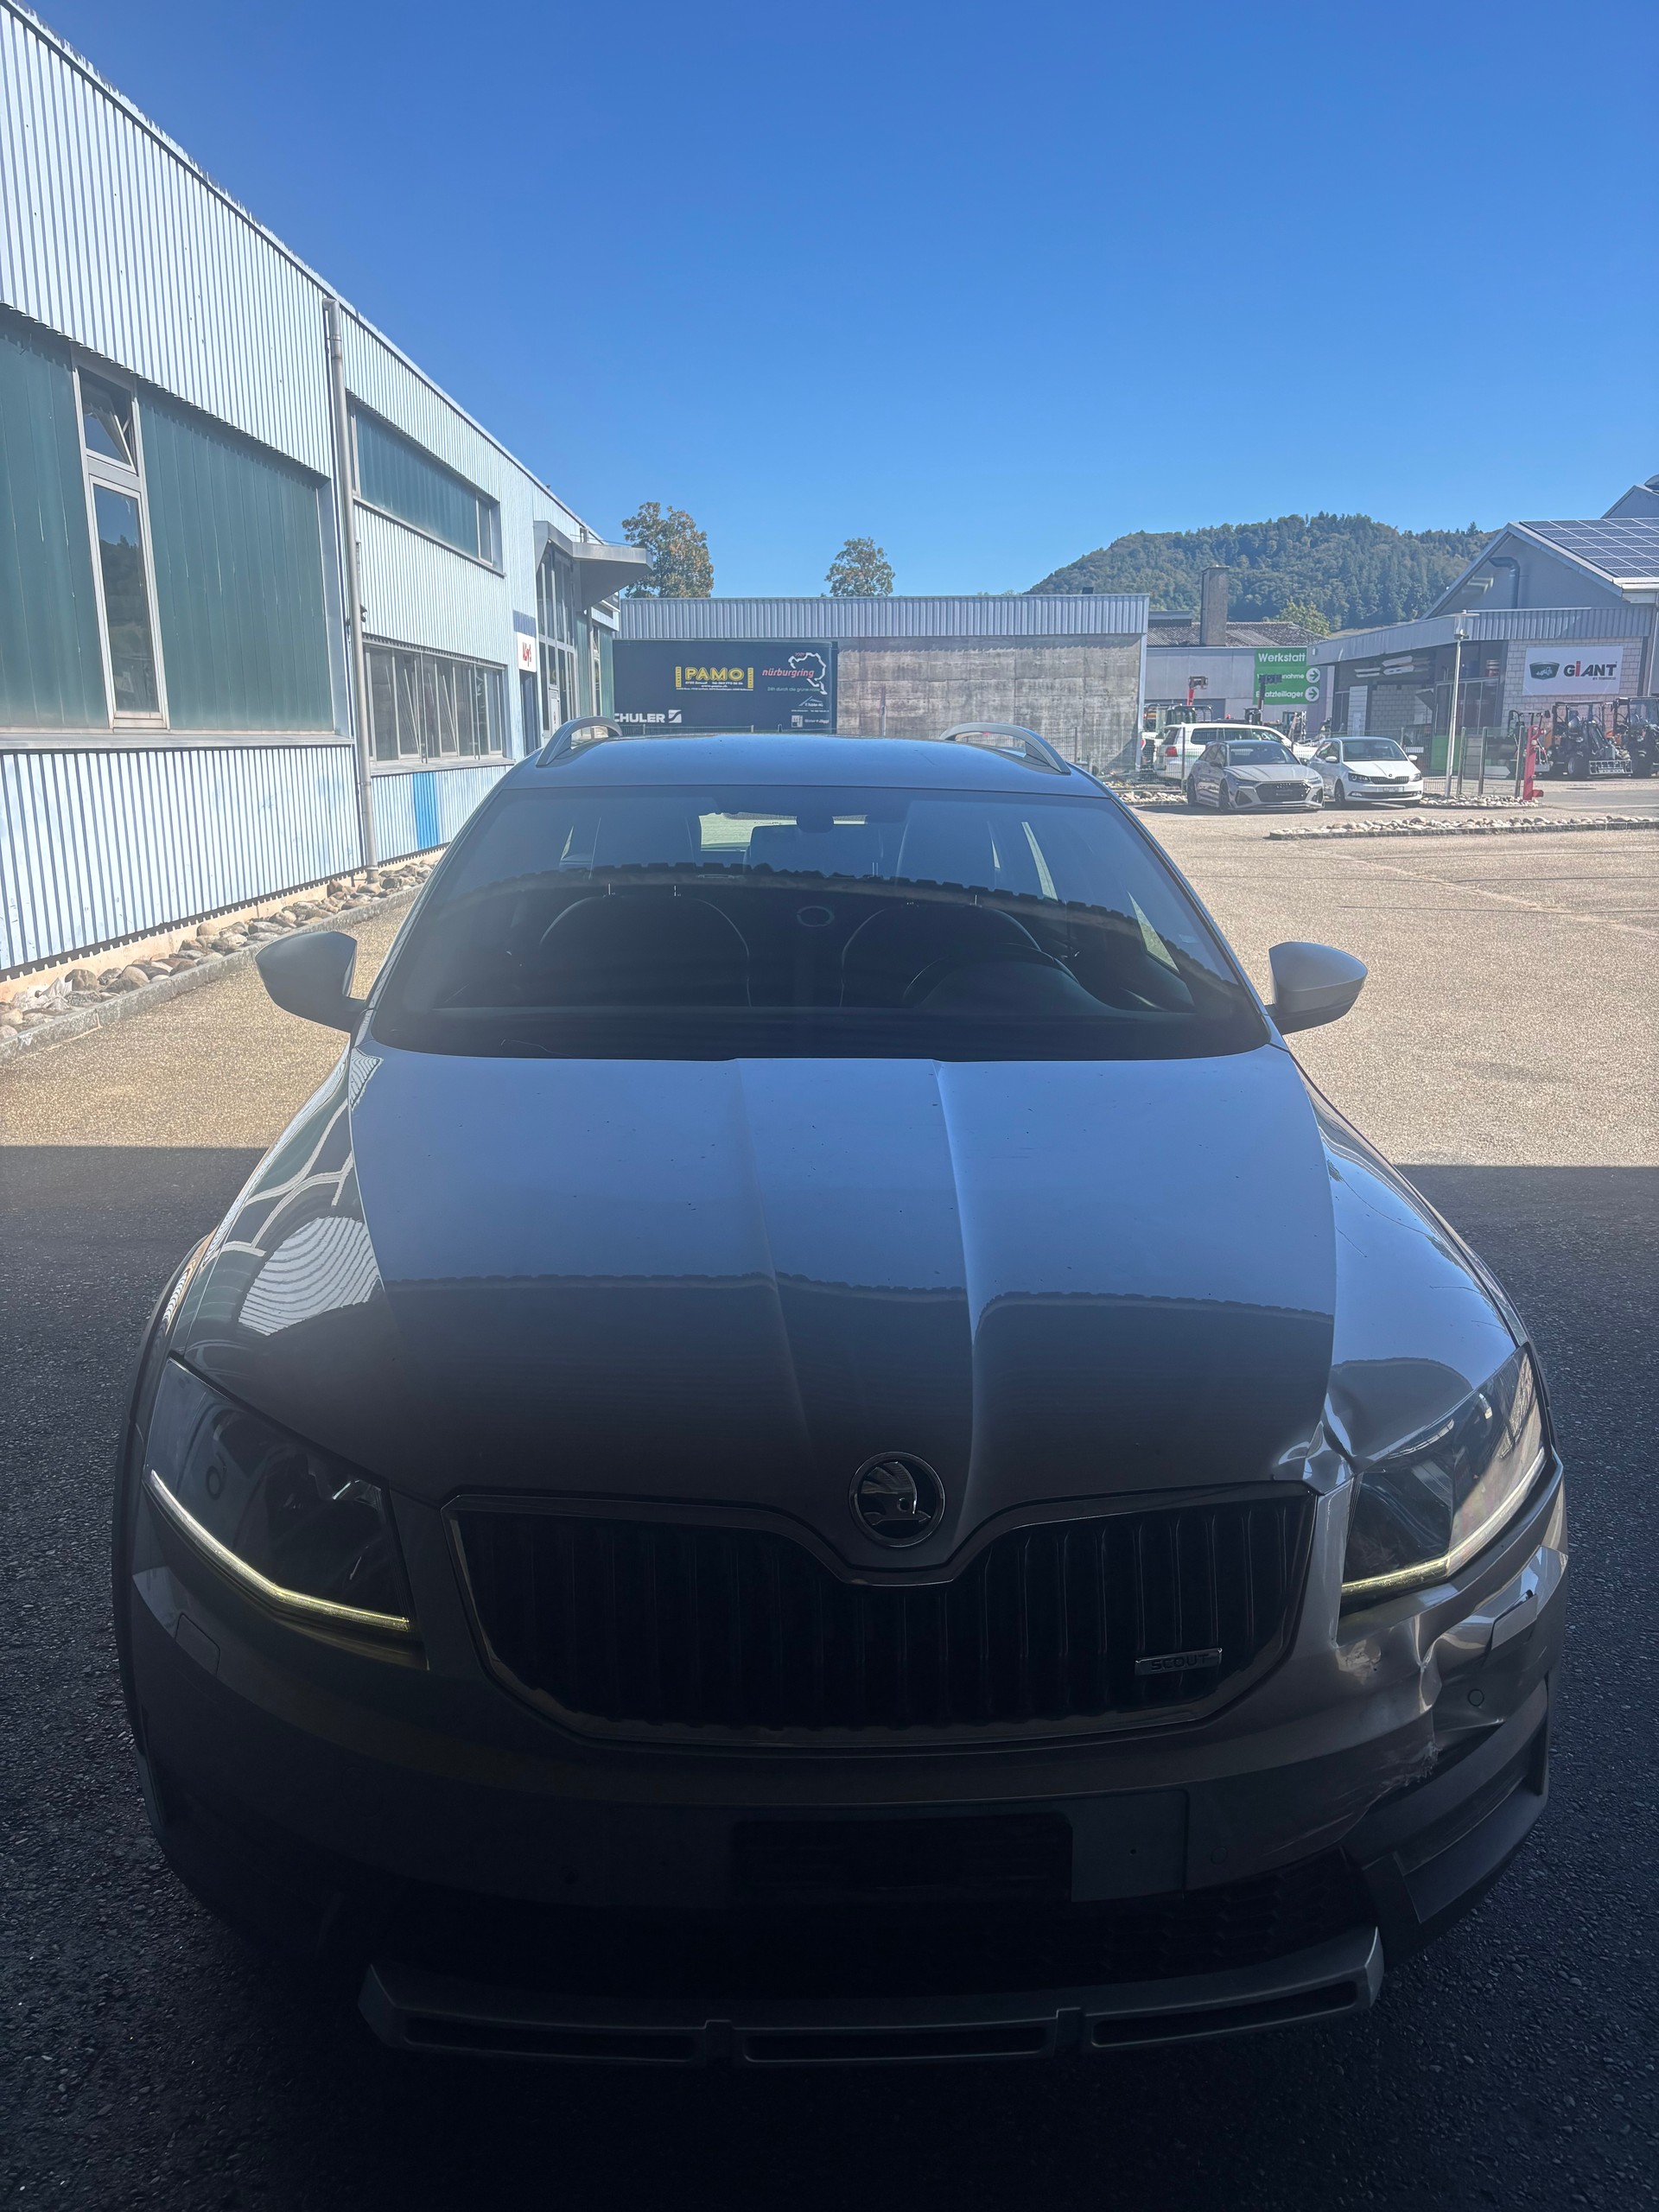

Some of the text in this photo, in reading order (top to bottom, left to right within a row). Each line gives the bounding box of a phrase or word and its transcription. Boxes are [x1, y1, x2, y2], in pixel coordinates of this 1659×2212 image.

[1258, 653, 1306, 662] Werkstatt
[685, 666, 745, 682] PAMO
[762, 668, 815, 678] nürburgring
[1151, 1653, 1210, 1671] SCOUT
